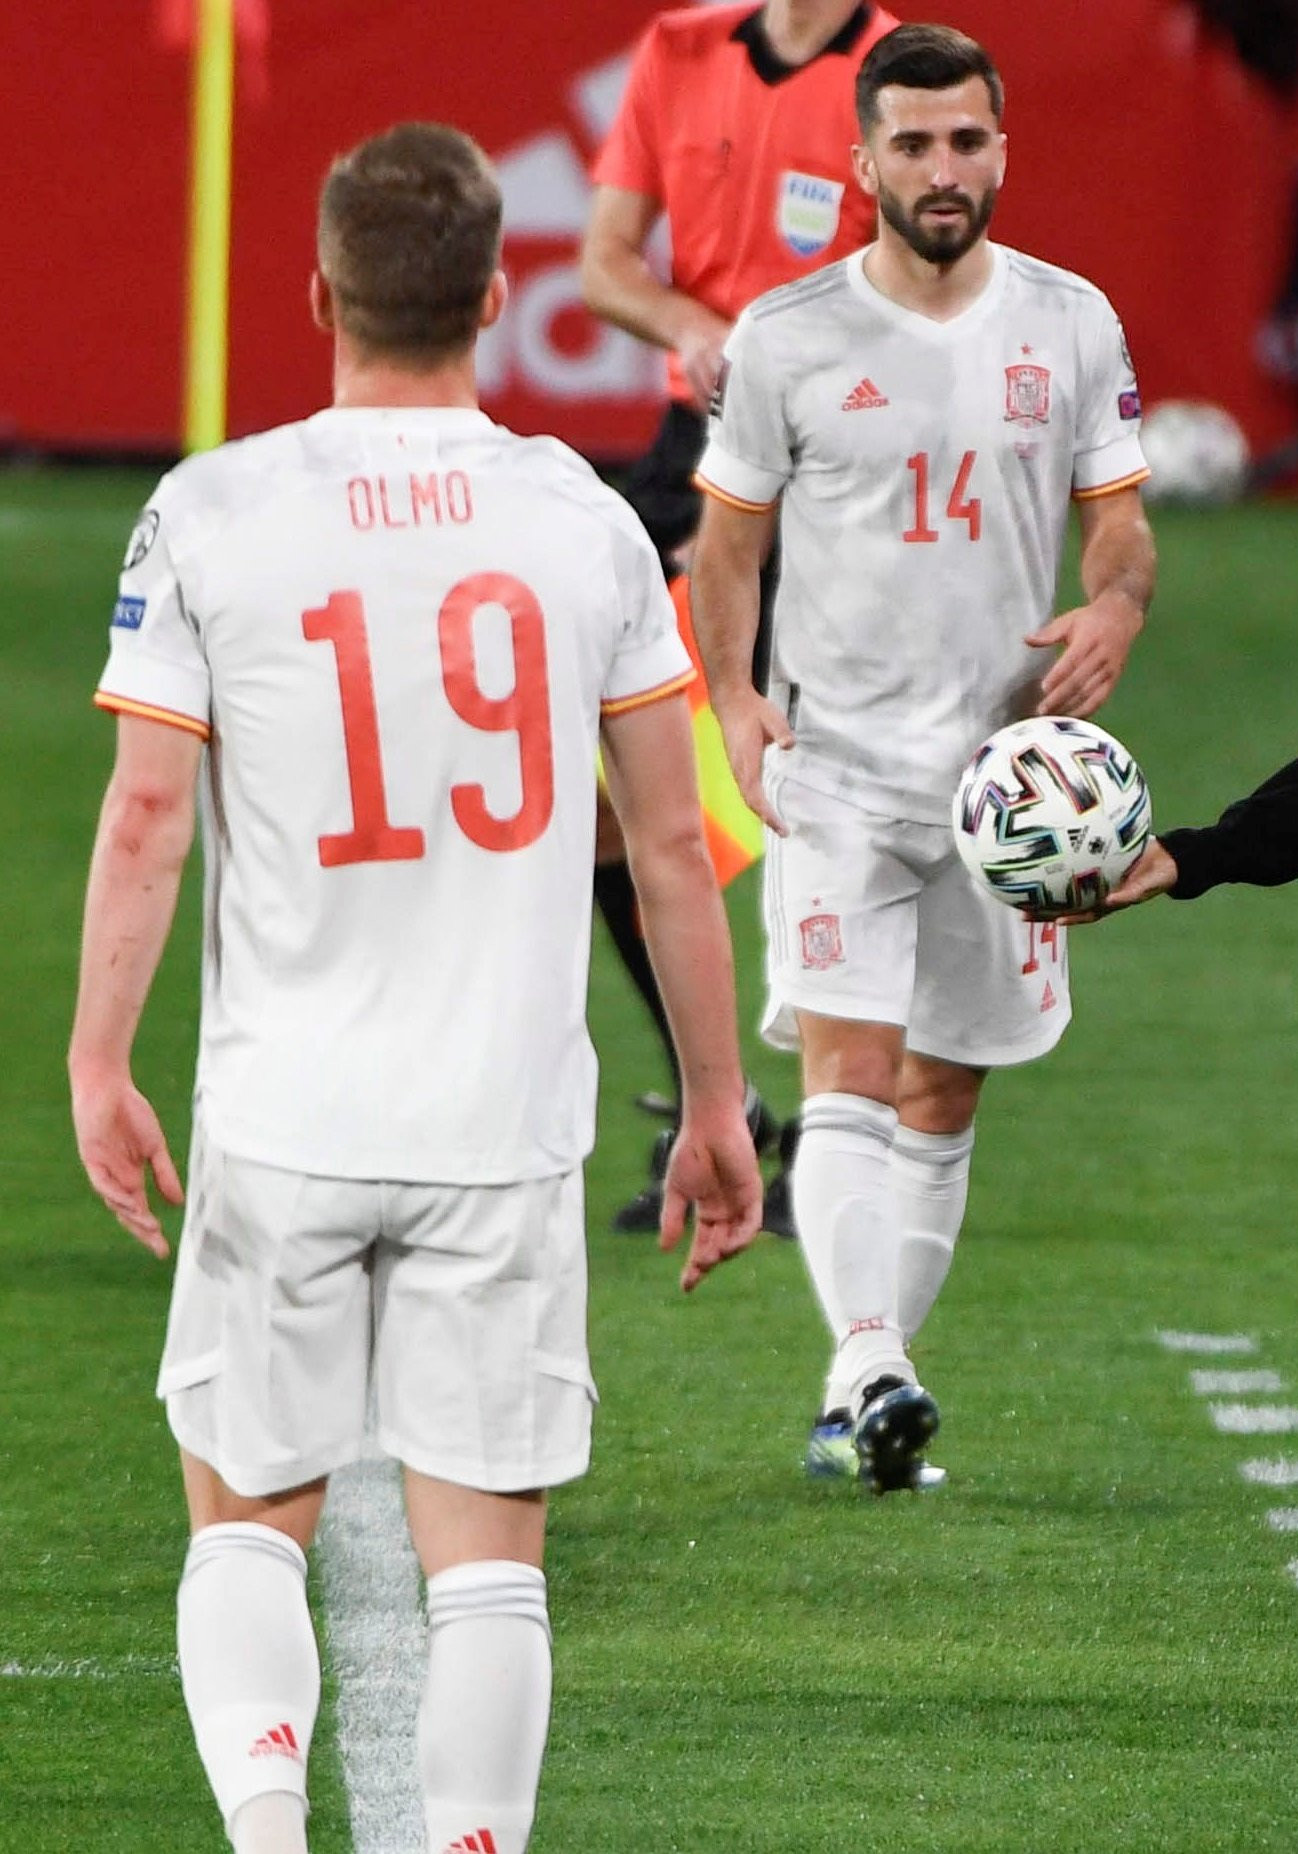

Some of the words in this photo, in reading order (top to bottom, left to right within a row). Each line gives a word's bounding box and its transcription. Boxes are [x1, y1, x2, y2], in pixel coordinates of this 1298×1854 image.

[842, 397, 889, 412] adidas
[347, 470, 473, 532] OLMO
[903, 450, 981, 542] 14
[302, 570, 554, 867] 19
